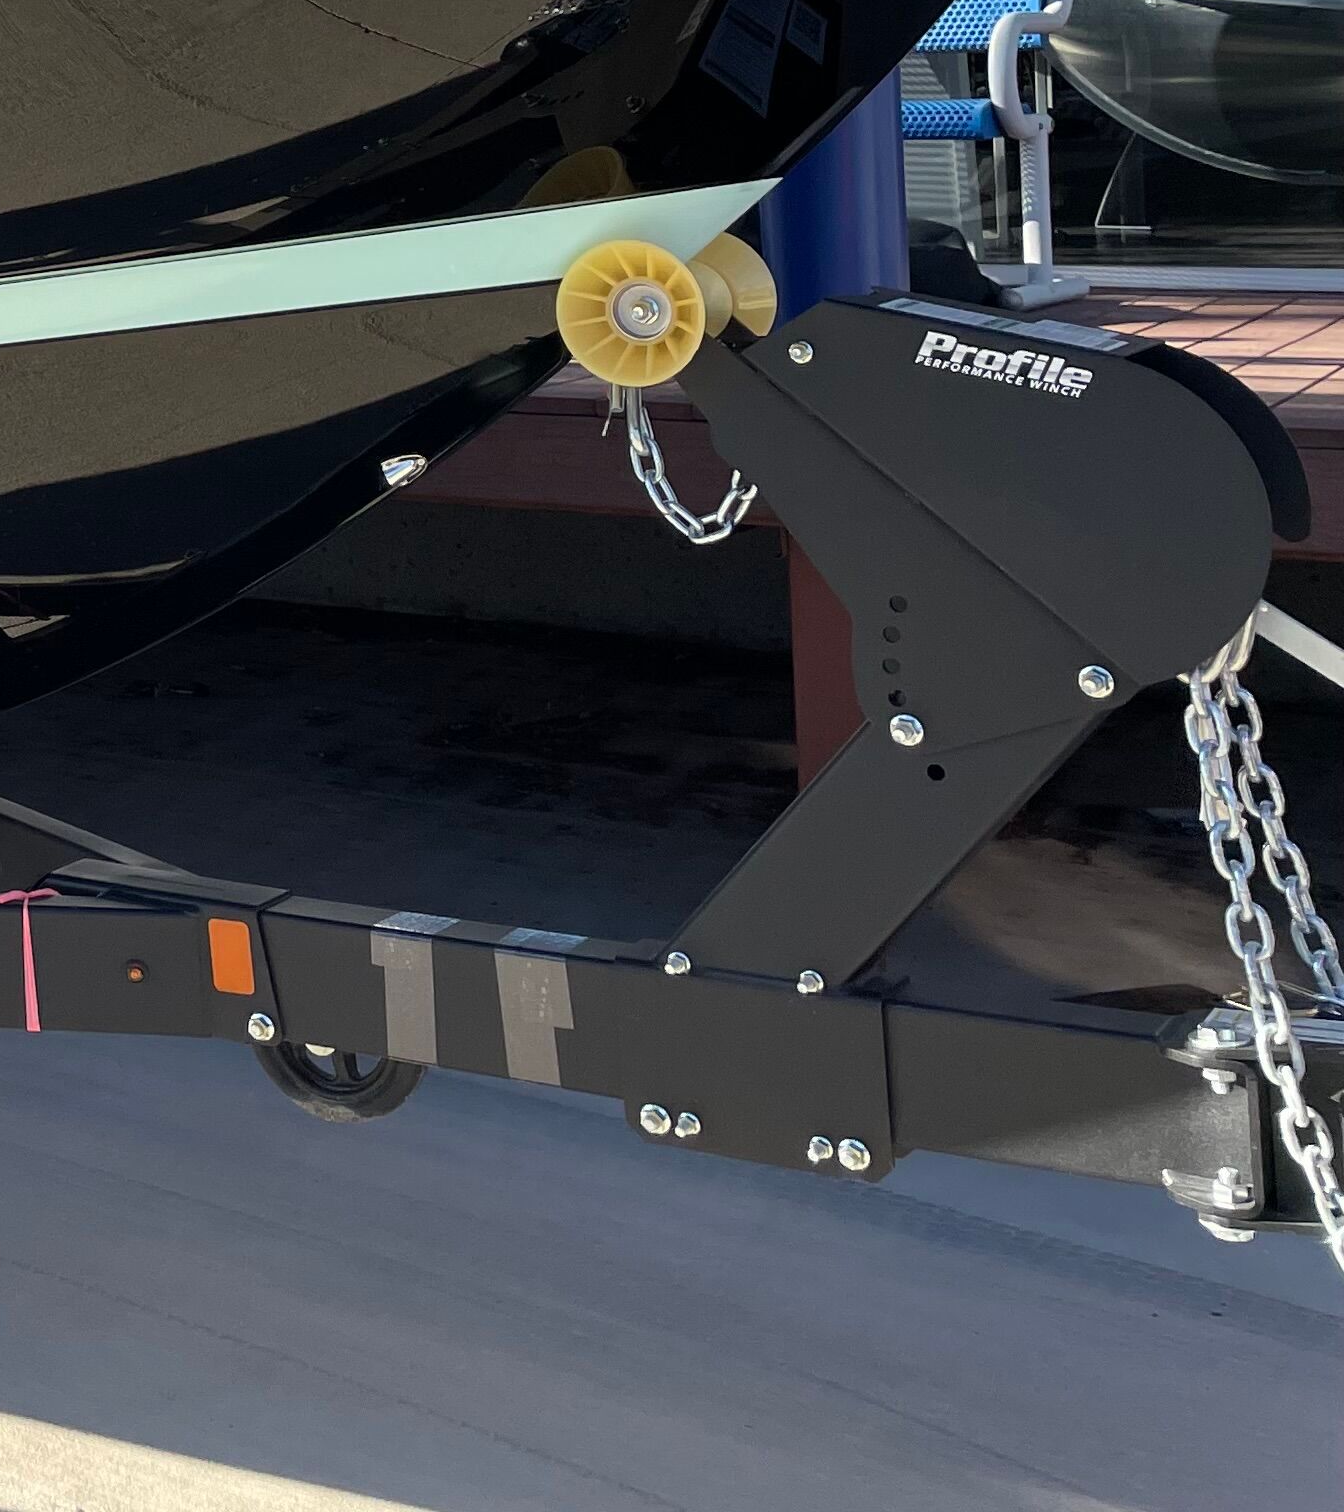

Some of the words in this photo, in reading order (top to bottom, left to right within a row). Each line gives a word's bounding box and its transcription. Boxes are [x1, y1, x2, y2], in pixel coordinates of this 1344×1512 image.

[914, 355, 1025, 387] PERFORMANCE
[1029, 379, 1082, 399] WINCH
[917, 330, 1094, 390] Profile
